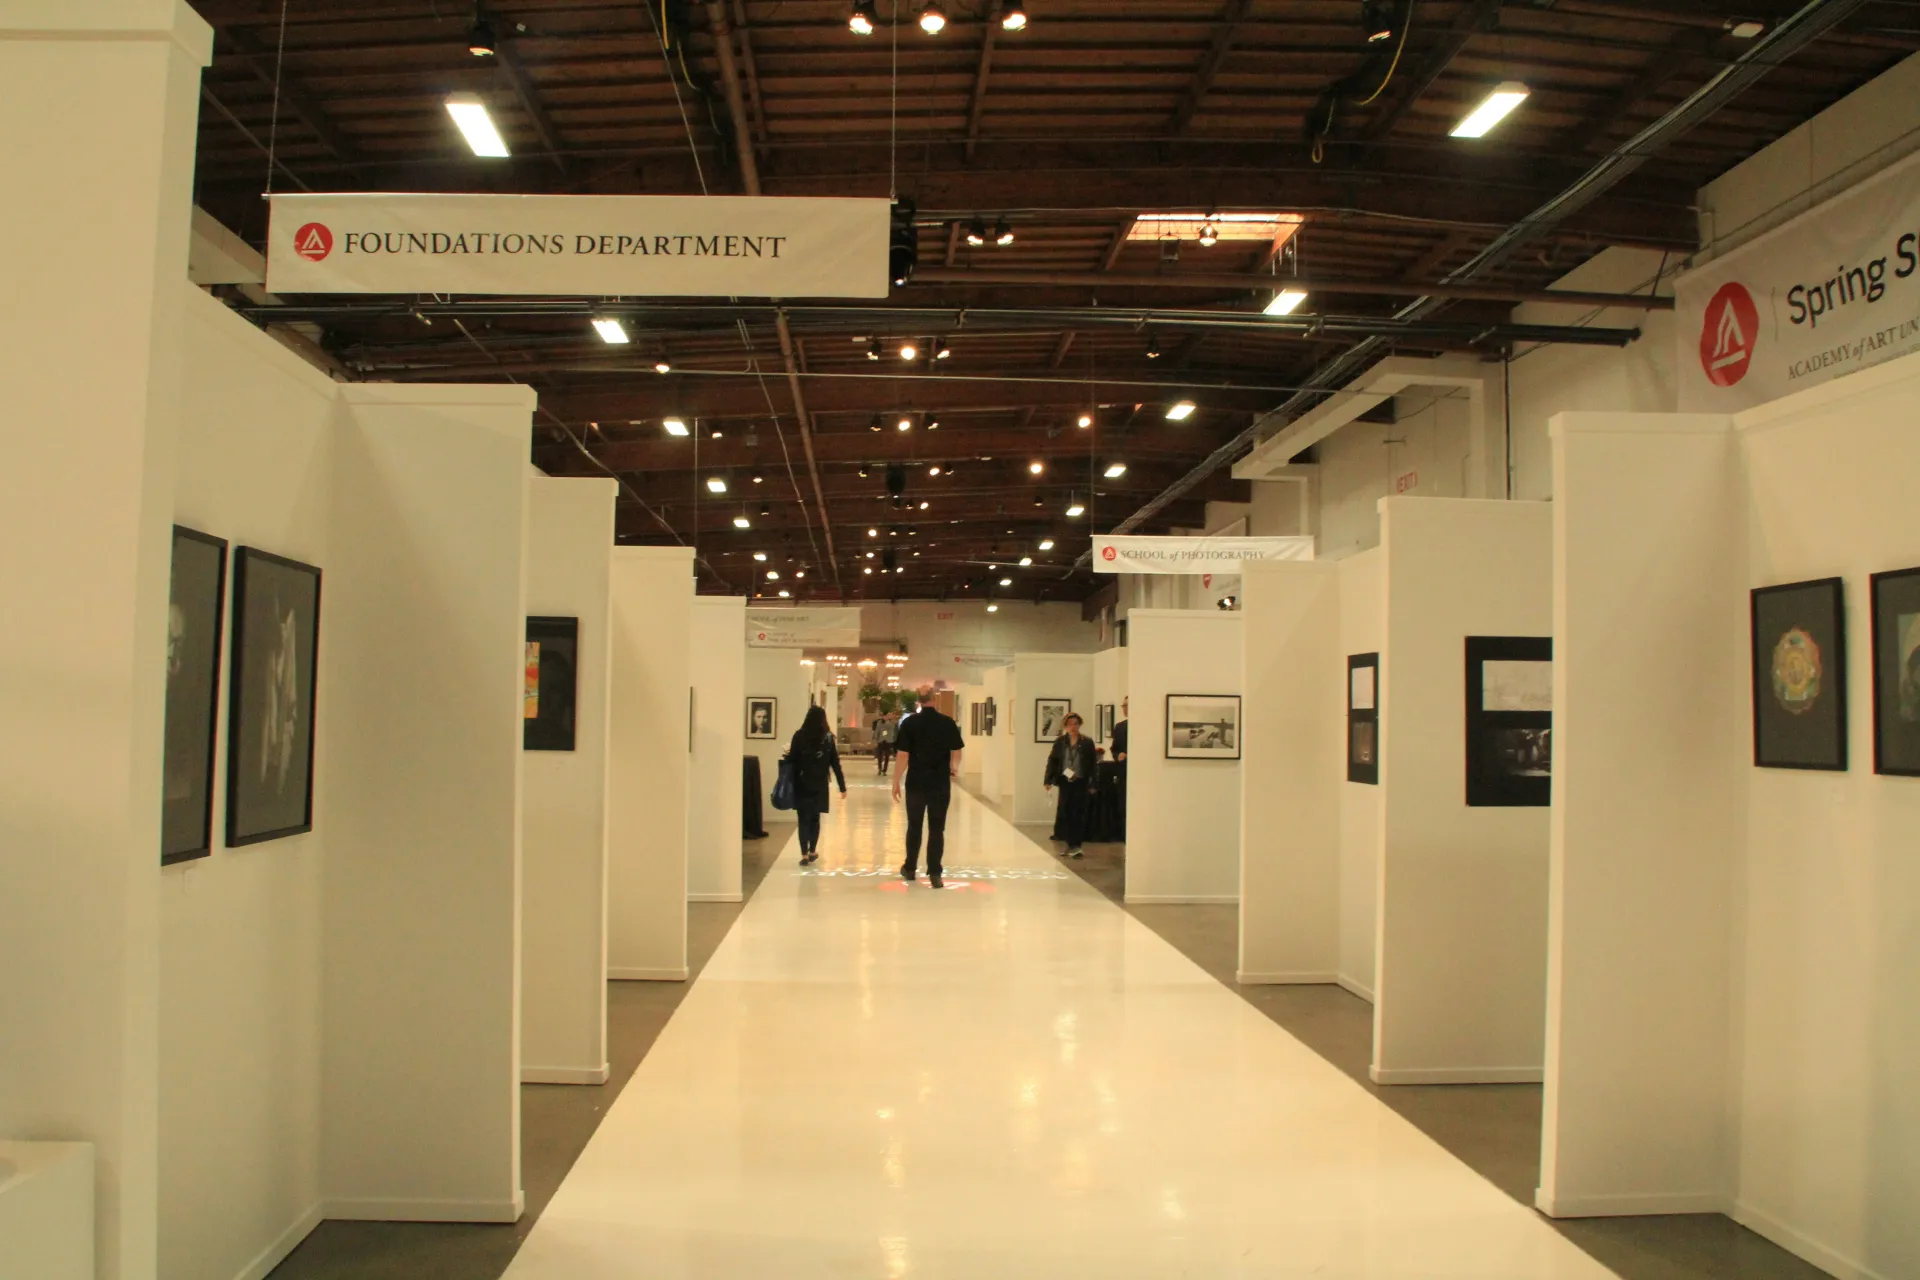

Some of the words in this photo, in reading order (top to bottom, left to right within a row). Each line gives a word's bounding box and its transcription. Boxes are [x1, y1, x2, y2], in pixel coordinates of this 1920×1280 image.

[344, 231, 565, 255] FOUNDATIONS
[574, 233, 788, 259] DEPARTMENT
[1787, 256, 1887, 328] Spring
[1788, 342, 1852, 380] ACADEMY
[1852, 337, 1867, 361] of
[1867, 326, 1897, 352] ART
[1120, 549, 1167, 560] SCHOOL
[1169, 549, 1180, 562] of
[1181, 550, 1265, 561] PHOTOGRAPHY
[937, 612, 955, 620] EXIT
